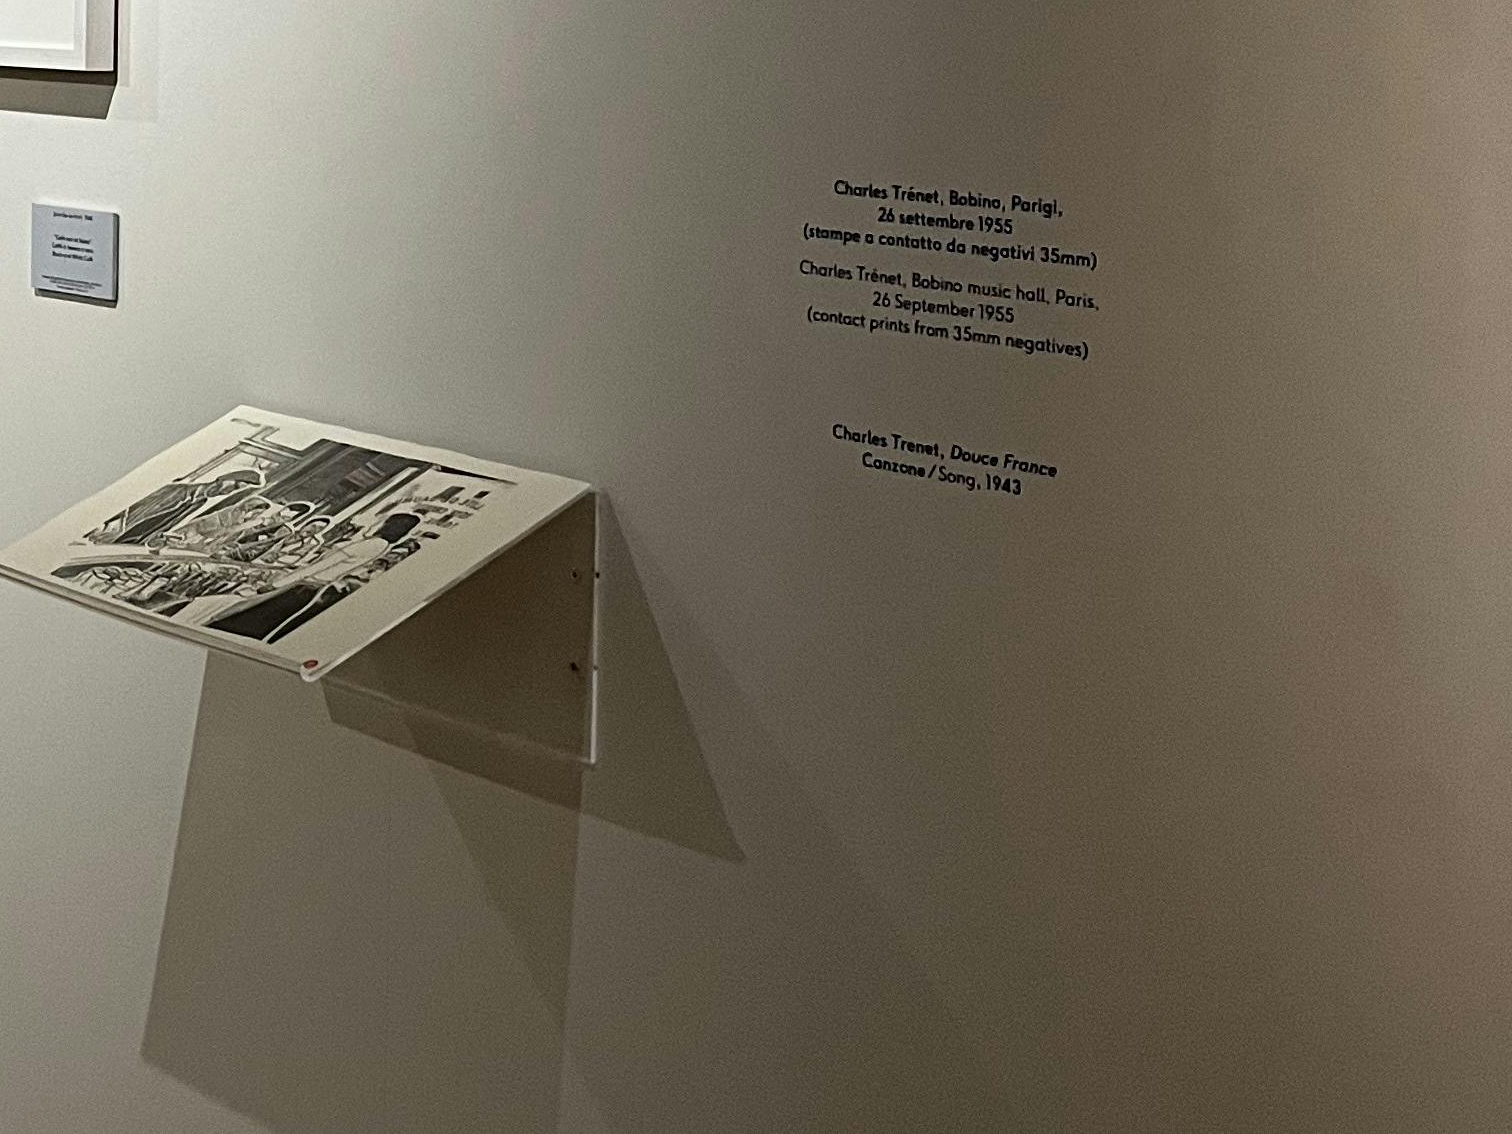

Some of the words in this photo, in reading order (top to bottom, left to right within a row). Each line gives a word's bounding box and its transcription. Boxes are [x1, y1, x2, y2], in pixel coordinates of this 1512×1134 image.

[834, 180, 888, 199] Charles
[892, 184, 944, 206] Trénet,
[949, 189, 1006, 212] Bobino,
[1011, 195, 1063, 218] Parigi,
[877, 207, 895, 222] 26
[899, 212, 975, 230] settembre
[979, 216, 1013, 235] 1955
[803, 222, 861, 245] (stampe
[865, 233, 874, 245] a
[878, 234, 942, 251] contatto
[946, 237, 966, 253] da
[971, 245, 1035, 262] negativi
[1040, 247, 1098, 271] 35mm)
[800, 259, 853, 280] Charles
[856, 266, 907, 288] Trénet,
[912, 272, 963, 293] Bobino
[967, 282, 1012, 299] music
[1016, 284, 1050, 305] hall,
[1055, 289, 1099, 311] Paris,
[872, 291, 891, 307] 26
[895, 294, 975, 318] September
[978, 304, 1015, 323] 1955
[807, 306, 866, 328] (contact
[869, 315, 910, 333] prints
[914, 319, 949, 339] from
[953, 325, 1001, 346] 35mm
[1005, 336, 1089, 361] negatives)
[832, 423, 888, 448] Charles
[891, 433, 945, 459] Trenet,
[950, 444, 999, 467] Douce
[1003, 454, 1058, 477] France
[986, 473, 1022, 495] 1943
